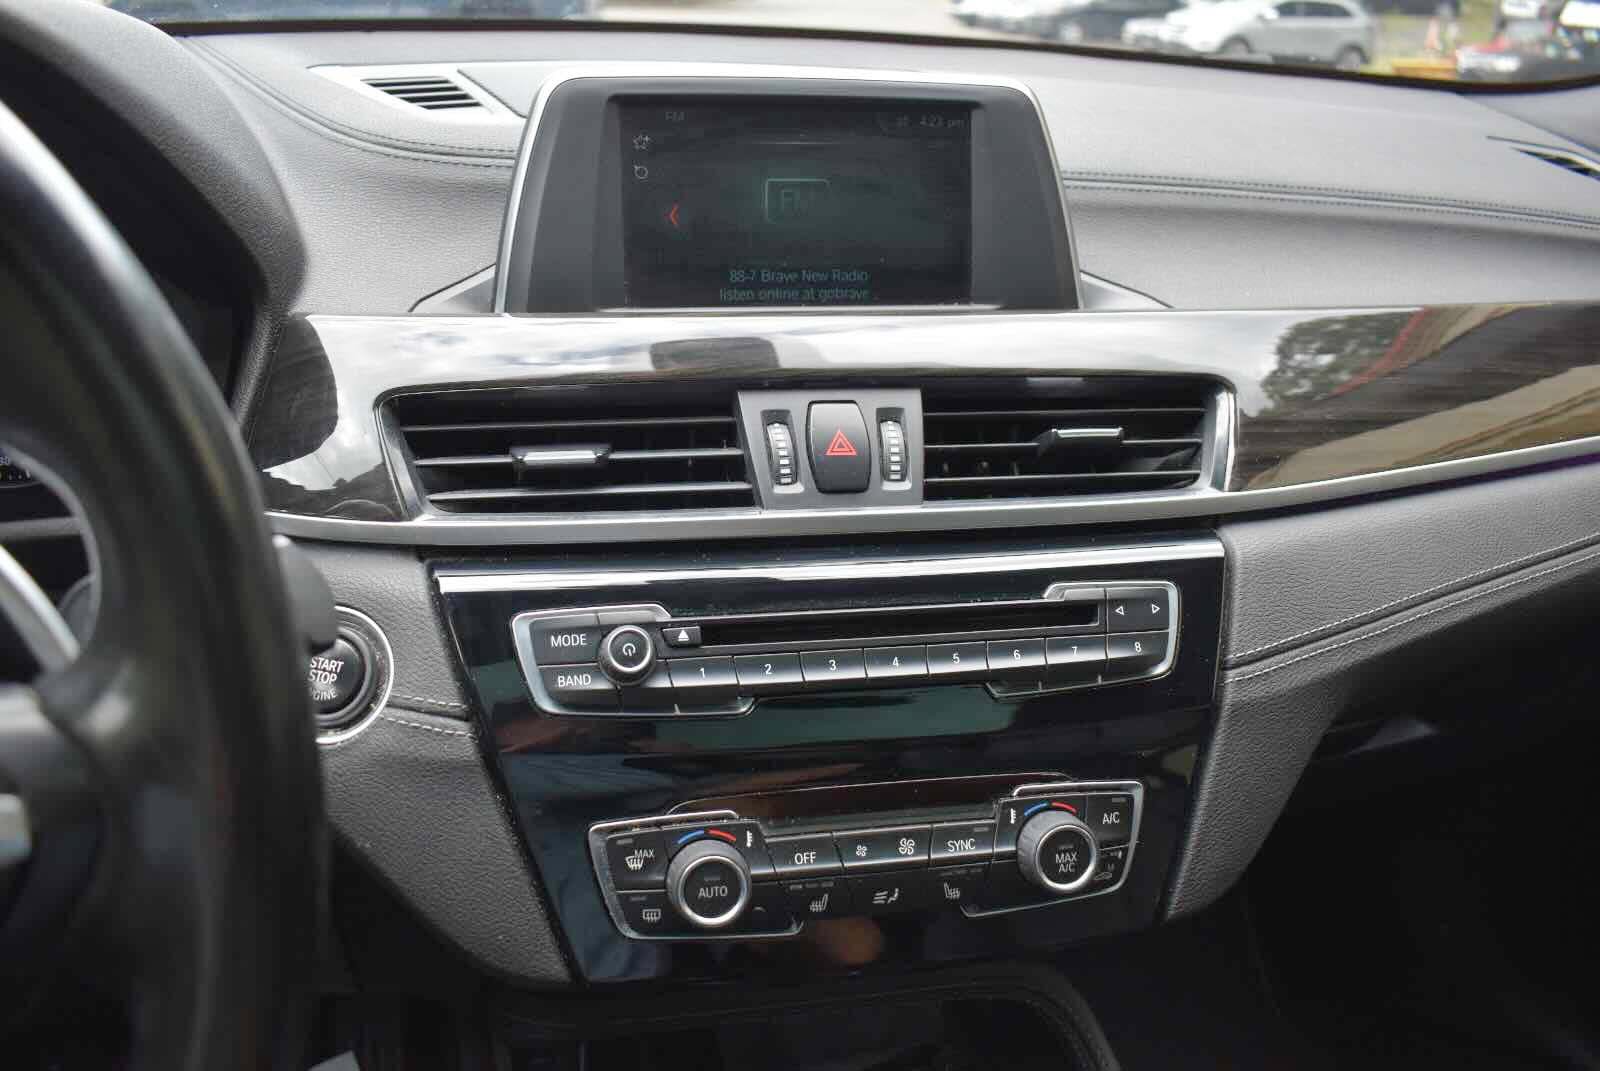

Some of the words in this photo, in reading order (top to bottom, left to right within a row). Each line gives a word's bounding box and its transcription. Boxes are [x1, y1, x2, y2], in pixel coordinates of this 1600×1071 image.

[665, 111, 685, 121] FM
[760, 270, 799, 282] Brave
[801, 270, 829, 282] New
[832, 269, 869, 282] Radio
[719, 287, 755, 302] listen
[758, 287, 800, 302] online
[801, 287, 815, 302] at
[550, 633, 587, 647] MODE
[1071, 645, 1078, 657] 7
[1134, 641, 1142, 653] 8
[953, 653, 960, 664] 5
[1013, 648, 1021, 660] 6
[310, 656, 345, 673] START
[829, 659, 837, 671] 3
[892, 656, 900, 667] 4
[699, 667, 706, 678] 1
[765, 663, 772, 675] 2
[307, 669, 338, 685] STOP
[557, 673, 592, 687] BAND
[1102, 811, 1120, 825] A/C
[947, 838, 976, 852] SYNC
[634, 848, 654, 859] MAX
[794, 852, 816, 865] OFF
[1055, 852, 1077, 864] MAX
[1058, 862, 1075, 873] A/C
[698, 886, 728, 898] AUTO
